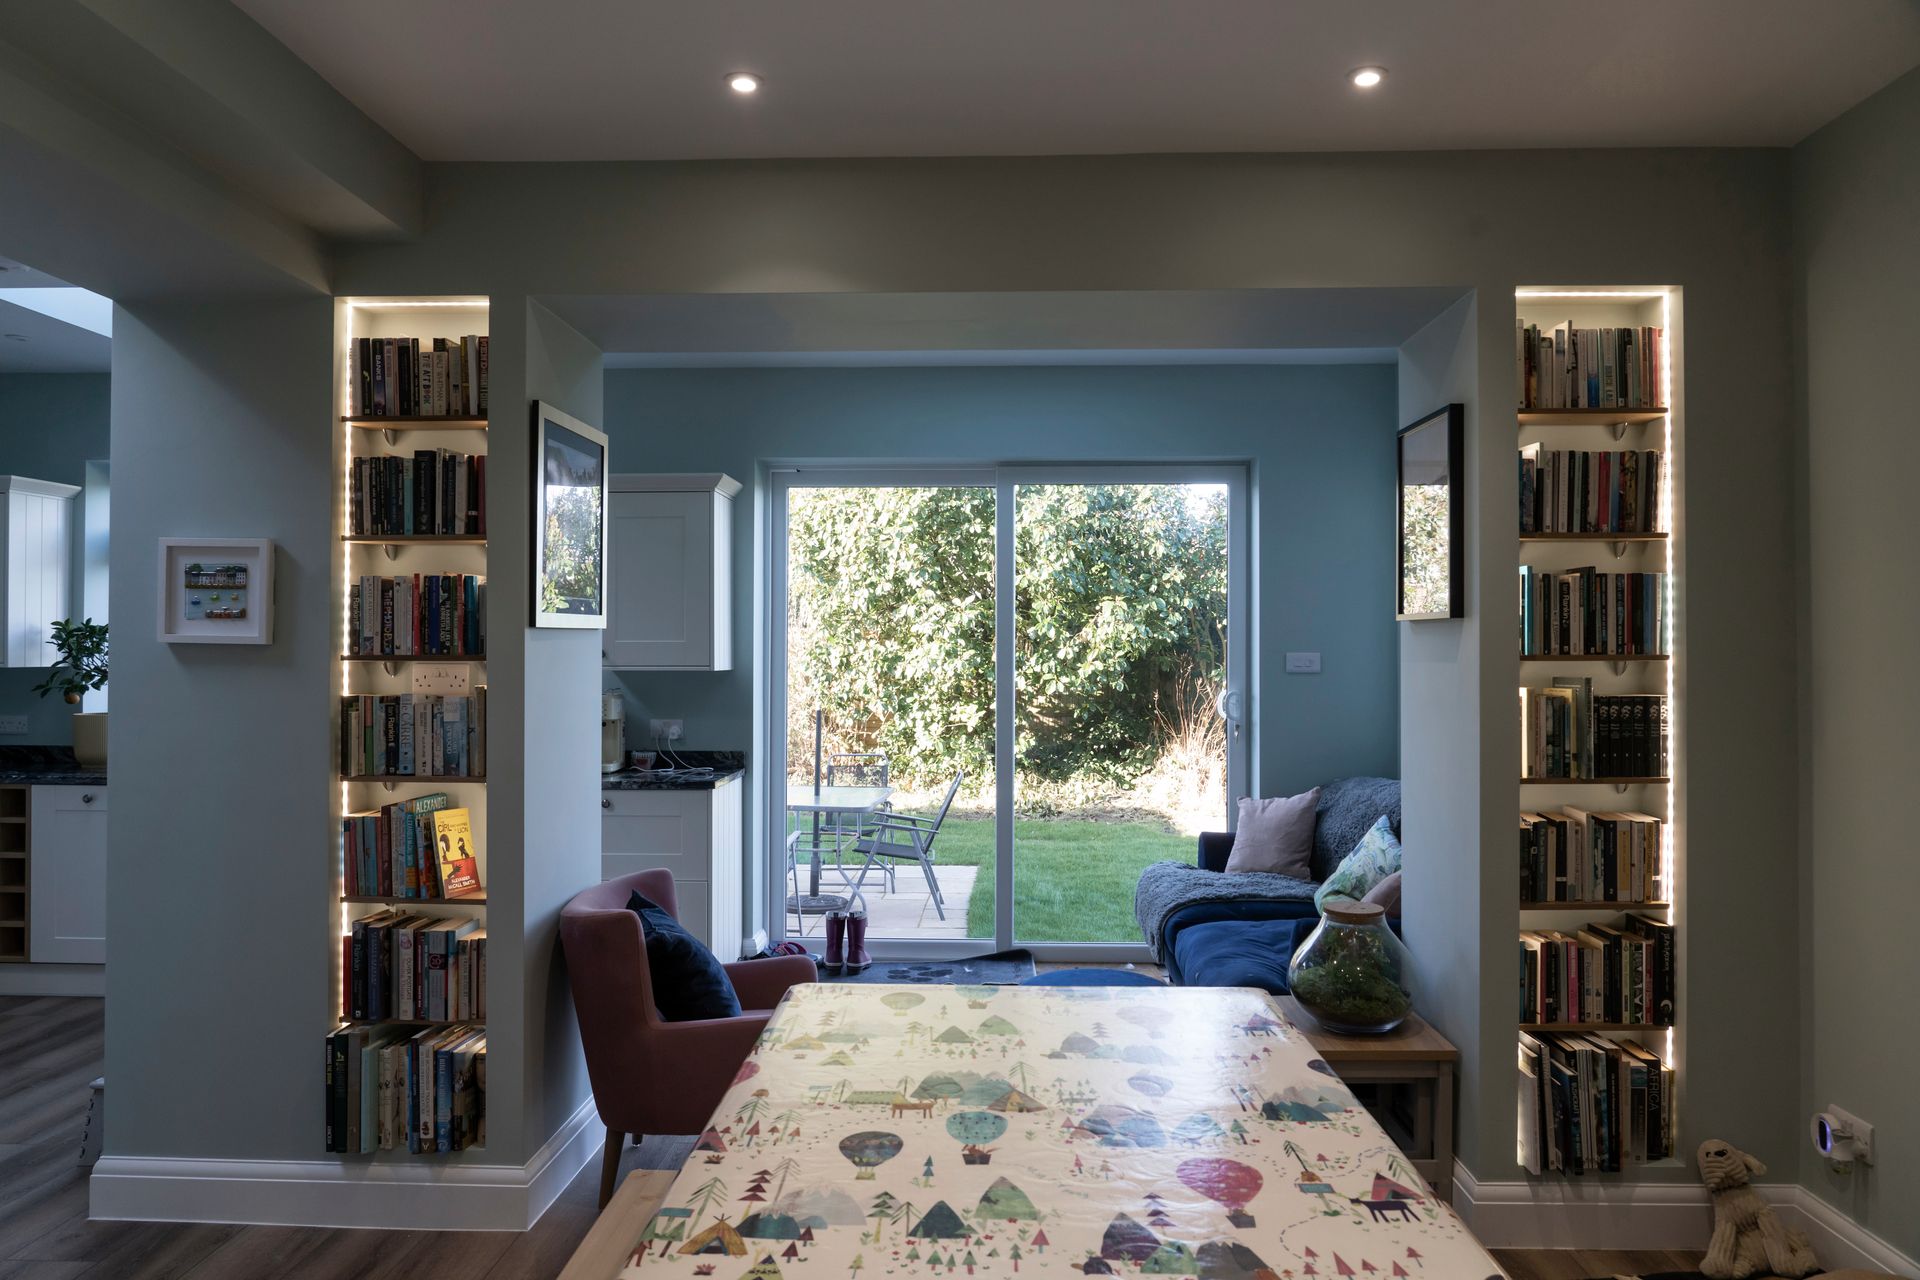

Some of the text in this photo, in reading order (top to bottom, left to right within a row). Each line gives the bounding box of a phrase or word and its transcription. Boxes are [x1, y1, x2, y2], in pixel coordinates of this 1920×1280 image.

[375, 354, 383, 381] BANKS
[388, 717, 397, 742] Rankin
[1648, 1066, 1660, 1112] AFRICA
